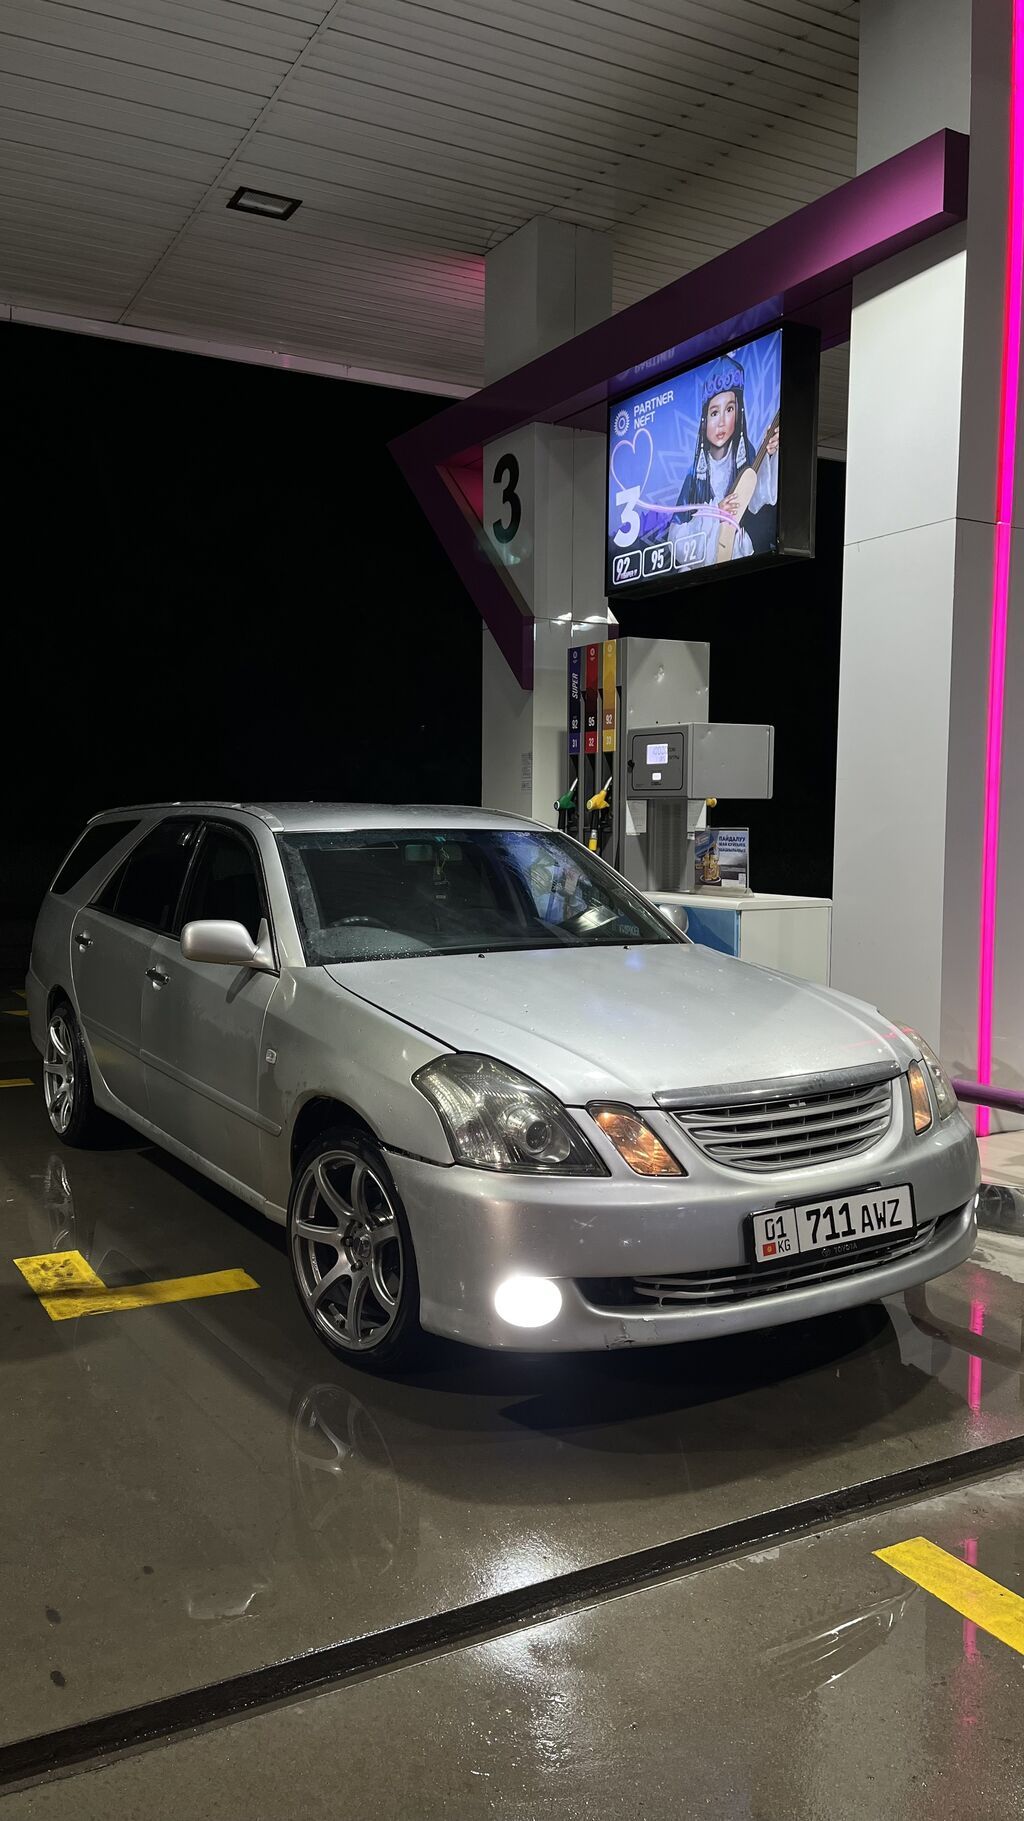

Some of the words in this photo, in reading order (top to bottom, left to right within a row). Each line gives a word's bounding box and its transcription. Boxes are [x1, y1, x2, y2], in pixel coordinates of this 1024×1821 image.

[633, 390, 674, 417] PARTNER
[633, 411, 656, 430] NEFT
[493, 453, 522, 544] 3
[613, 485, 641, 548] 3
[616, 557, 631, 581] 92
[651, 548, 665, 571] 95
[683, 539, 697, 562] 92
[571, 672, 579, 699] SUPER
[588, 716, 595, 727] 95
[605, 714, 613, 725] 92
[764, 1215, 787, 1241] 01
[806, 1202, 856, 1244] 711
[861, 1198, 902, 1233] AWZ
[777, 1239, 791, 1254] KG
